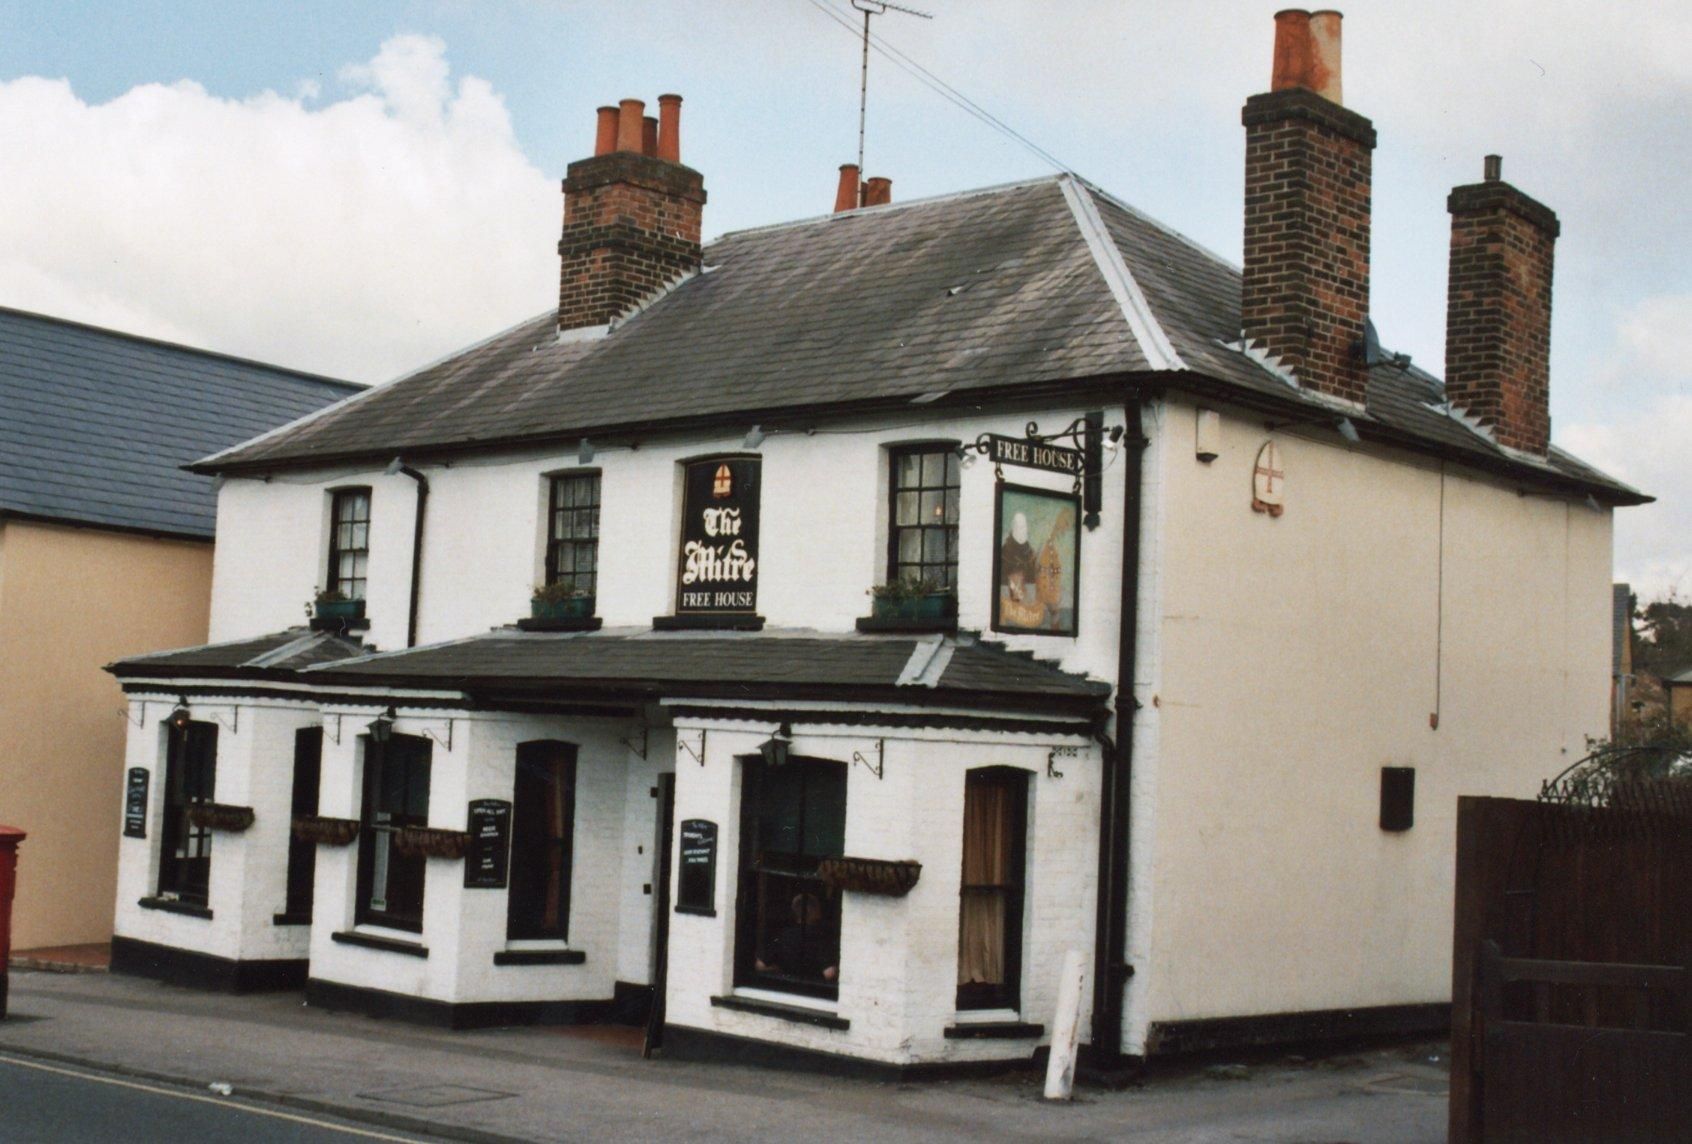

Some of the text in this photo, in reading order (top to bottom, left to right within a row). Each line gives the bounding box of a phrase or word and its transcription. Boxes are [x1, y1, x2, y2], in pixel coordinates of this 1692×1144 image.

[997, 440, 1075, 470] FREE HOUSE
[703, 507, 742, 537] The
[682, 539, 755, 585] Mitre
[683, 592, 753, 607] FREE HOUSE
